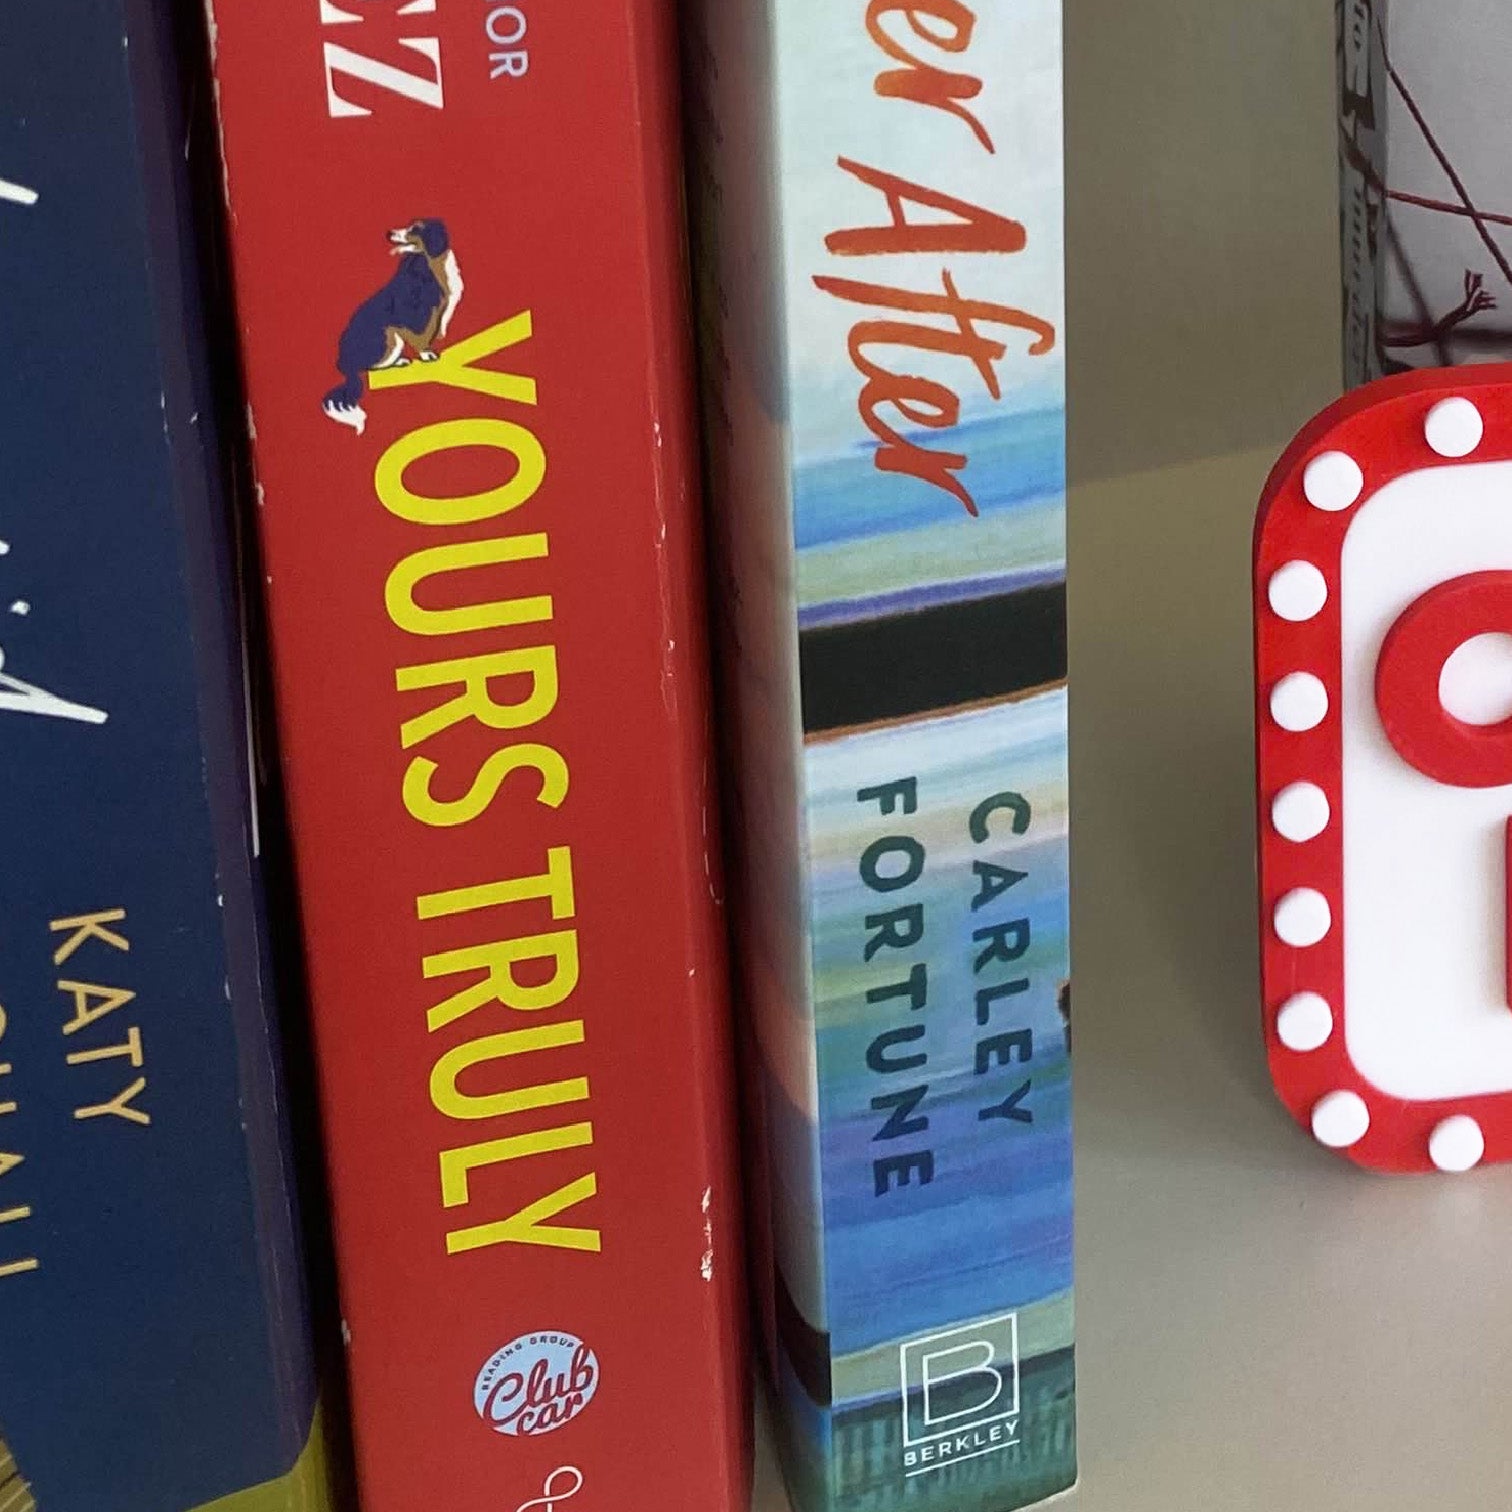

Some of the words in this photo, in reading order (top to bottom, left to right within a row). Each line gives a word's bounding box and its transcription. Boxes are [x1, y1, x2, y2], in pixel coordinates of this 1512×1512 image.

[811, 154, 1057, 518] After
[368, 309, 570, 827] YOURS
[50, 907, 150, 1125] KATY
[416, 845, 601, 1255] TRULY
[857, 776, 935, 1198] FORTUNE
[969, 790, 1033, 1124] CARLEY
[483, 1344, 594, 1426] Club
[517, 1392, 583, 1435] car
[529, 1335, 575, 1349] GROUP
[904, 1419, 1018, 1466] BERKLEY
[922, 1340, 1002, 1426] B
